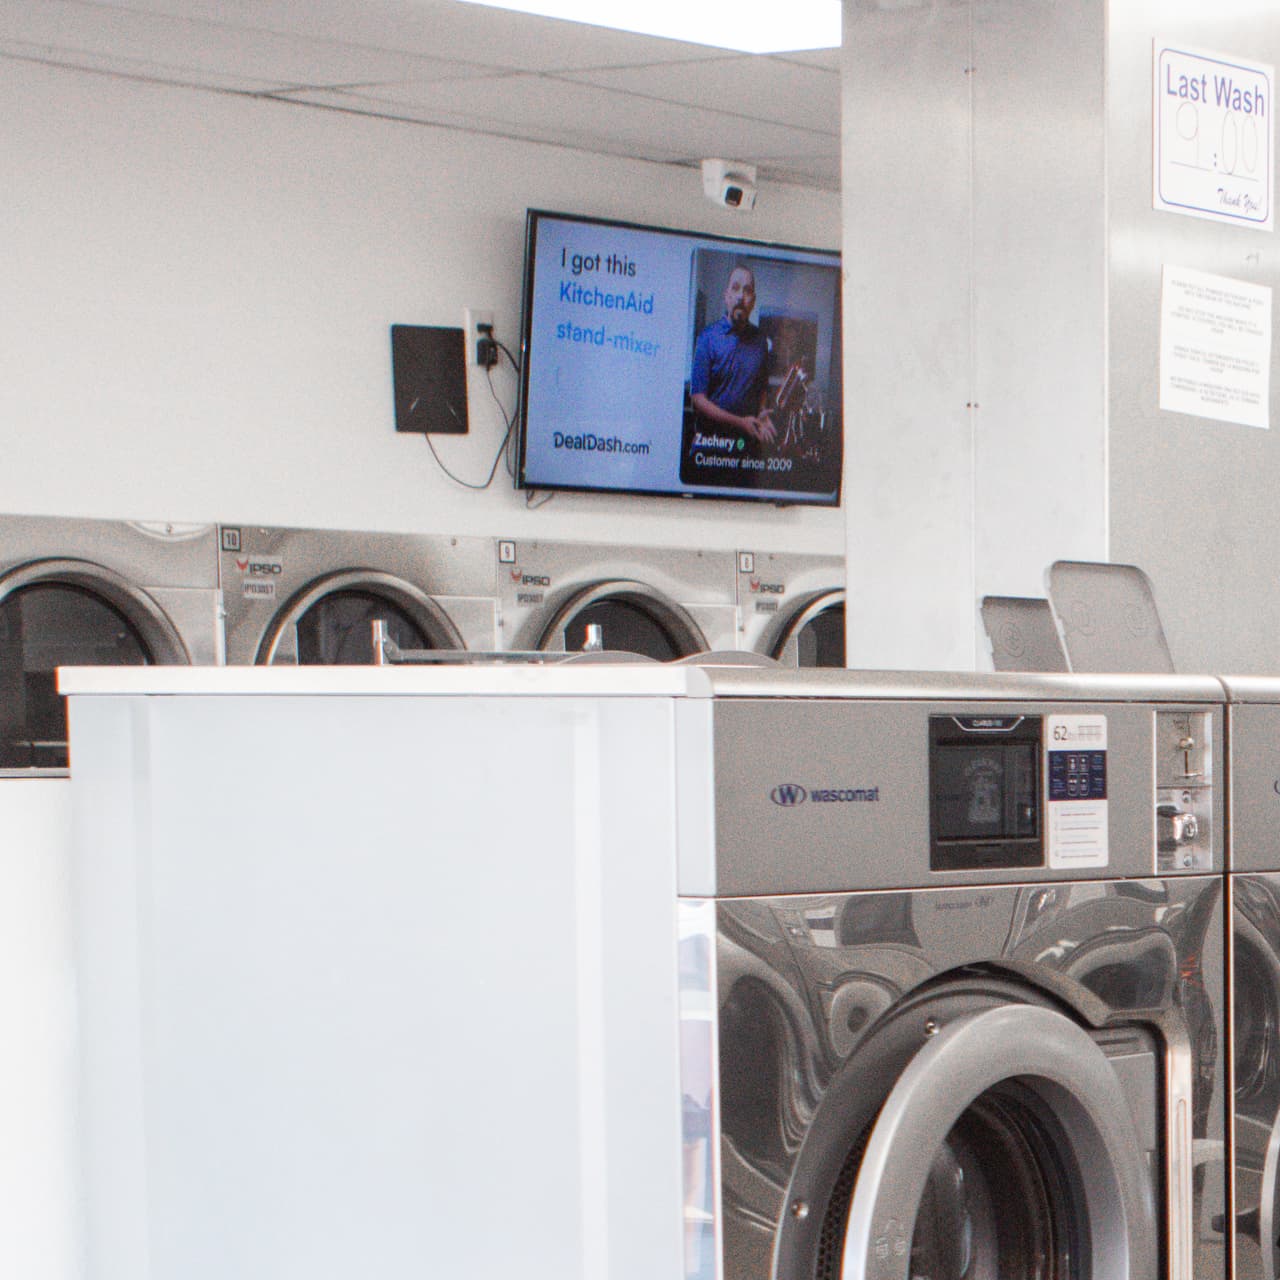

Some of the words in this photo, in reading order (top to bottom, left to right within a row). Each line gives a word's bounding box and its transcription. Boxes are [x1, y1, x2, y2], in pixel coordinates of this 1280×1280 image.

[1167, 63, 1207, 104] Last
[1214, 74, 1265, 117] Wash
[561, 247, 567, 268] I
[571, 253, 602, 275] got
[606, 253, 637, 277] this
[559, 281, 654, 315] KitchenAid
[556, 321, 661, 357] stand-mixer
[553, 431, 650, 455] DealDash.com
[694, 432, 736, 450] Zachary
[694, 454, 740, 469] Customer
[741, 455, 766, 470] since
[767, 457, 793, 472] 2009
[249, 563, 282, 576] IPSO
[522, 575, 550, 586] IPSO
[1053, 725, 1068, 741] 62
[811, 785, 880, 803] wascomat
